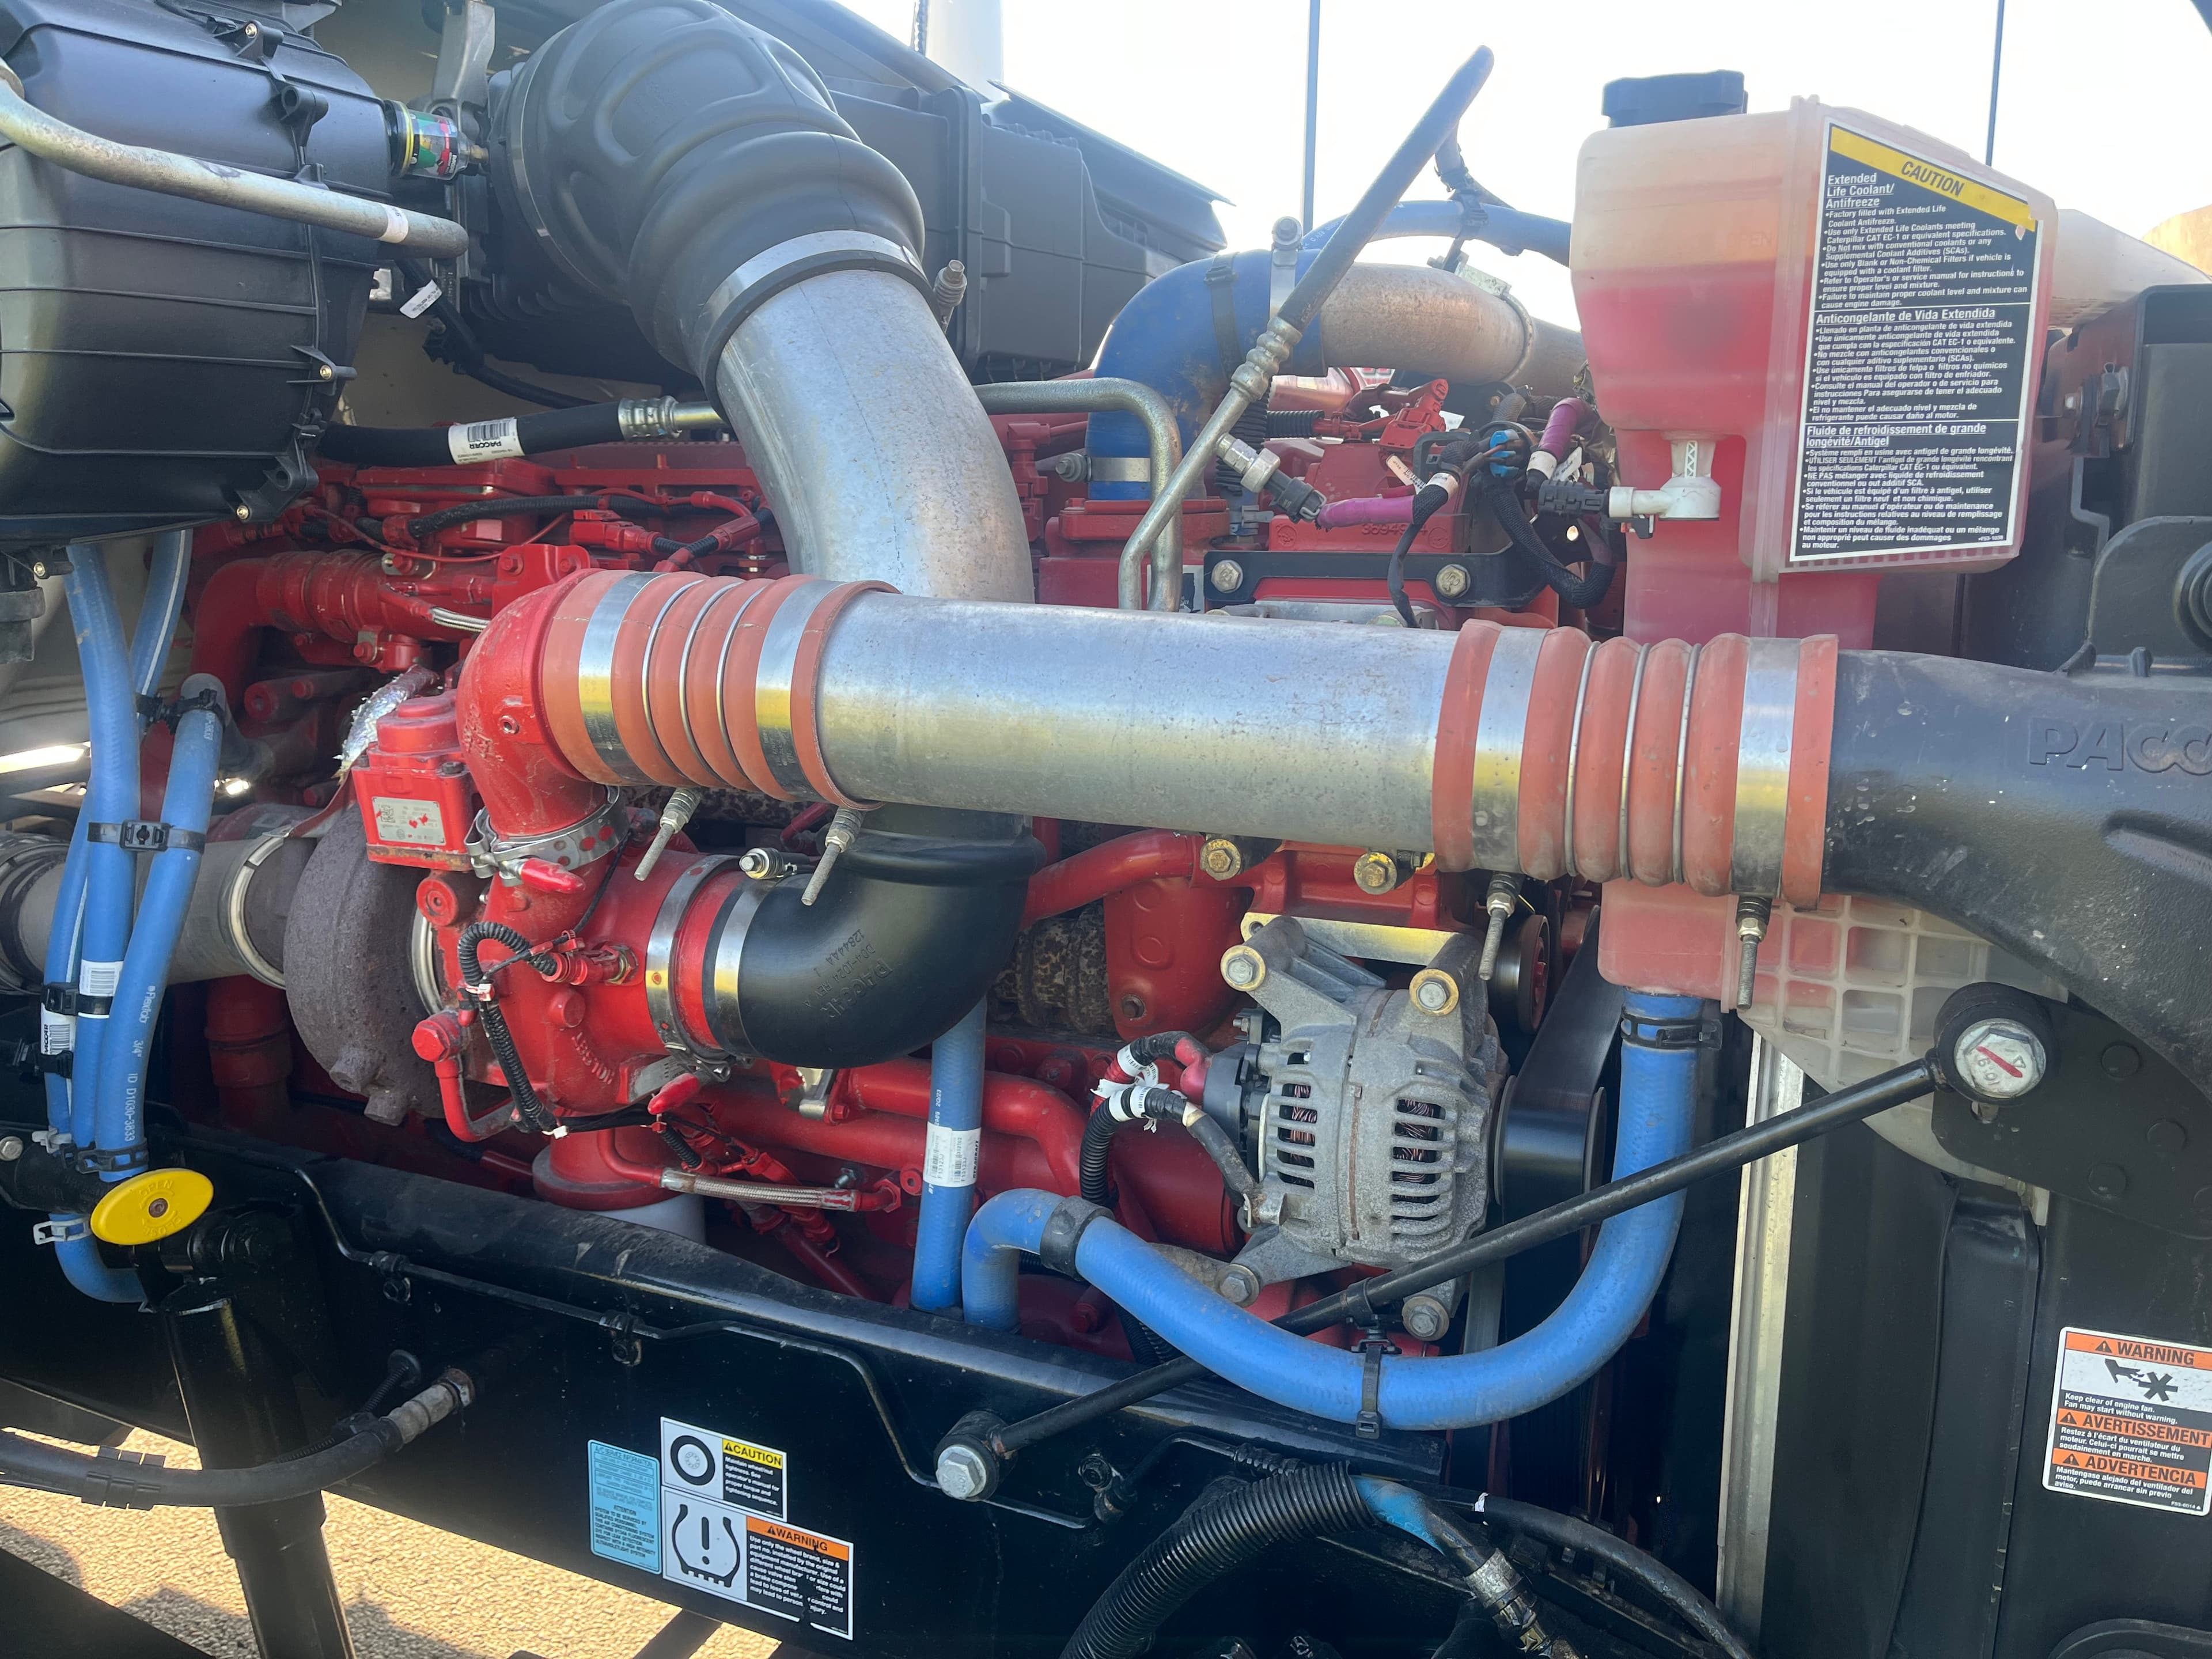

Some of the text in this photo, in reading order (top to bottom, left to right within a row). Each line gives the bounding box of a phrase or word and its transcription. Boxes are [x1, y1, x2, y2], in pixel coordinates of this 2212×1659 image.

[1827, 173, 1877, 184] Extended
[1902, 161, 1965, 196] CAUTION
[1826, 184, 1894, 195] Life Coolant/
[1826, 196, 1880, 207] Antifreeze
[1828, 209, 1857, 218] Factory
[1896, 205, 1930, 213] Extended
[1842, 226, 1858, 235] only
[1859, 225, 1894, 233] Extended
[1911, 222, 1944, 230] Coolants
[1944, 221, 1976, 230] meeting
[1858, 217, 1896, 225] Antifreeze.
[1826, 234, 1865, 244] Caterpillar
[1911, 230, 1950, 240] equivalent
[1951, 228, 2007, 238] specifications.
[1885, 240, 1933, 248] conventional
[1977, 238, 1991, 246] any
[1825, 251, 1875, 260] Supplemental
[1876, 249, 1905, 257] Coolant
[1942, 247, 1970, 255] (SCAs).
[1840, 259, 1855, 268] only
[1889, 256, 1942, 264] Non-Chemical
[1975, 253, 2002, 261] vehicle
[1816, 308, 1996, 324] Anticongelante de Vida Extendida
[1806, 423, 1987, 434] Fluide de refroidissement de grande
[1805, 436, 1889, 447] longévité/Antigel
[815, 980, 832, 998] REV
[2116, 1342, 2195, 1365] WARNING
[2065, 1393, 2084, 1402] Keep
[2085, 1396, 2104, 1404] clear
[2114, 1400, 2139, 1411] engine
[2141, 1404, 2154, 1412] fan.
[2064, 1400, 2177, 1425] Fan may start without warning.
[2082, 1414, 2210, 1445] AVERTISSEMENT
[2060, 1434, 2087, 1444] moteur.
[2089, 1439, 2116, 1449] Celui-ci
[2118, 1444, 2147, 1455] pourrait
[2160, 1450, 2184, 1460] mettre
[2061, 1427, 2085, 1437] Restez
[2093, 1432, 2117, 1441] l'écart
[2130, 1438, 2169, 1450] ventilateur
[733, 1444, 781, 1466] CAUTION
[2059, 1441, 2110, 1456] soudainement
[2123, 1452, 2152, 1462] marche.
[2085, 1456, 2196, 1485] ADVERTENCIA
[2054, 1480, 2075, 1489] aviso.
[2055, 1473, 2078, 1483] motor,
[2080, 1477, 2101, 1487] puede
[2103, 1482, 2134, 1492] arrancar
[2149, 1489, 2172, 1499] previo
[2056, 1466, 2192, 1495] Mantengase alejado del ventilador del
[777, 1527, 827, 1551] WARNING
